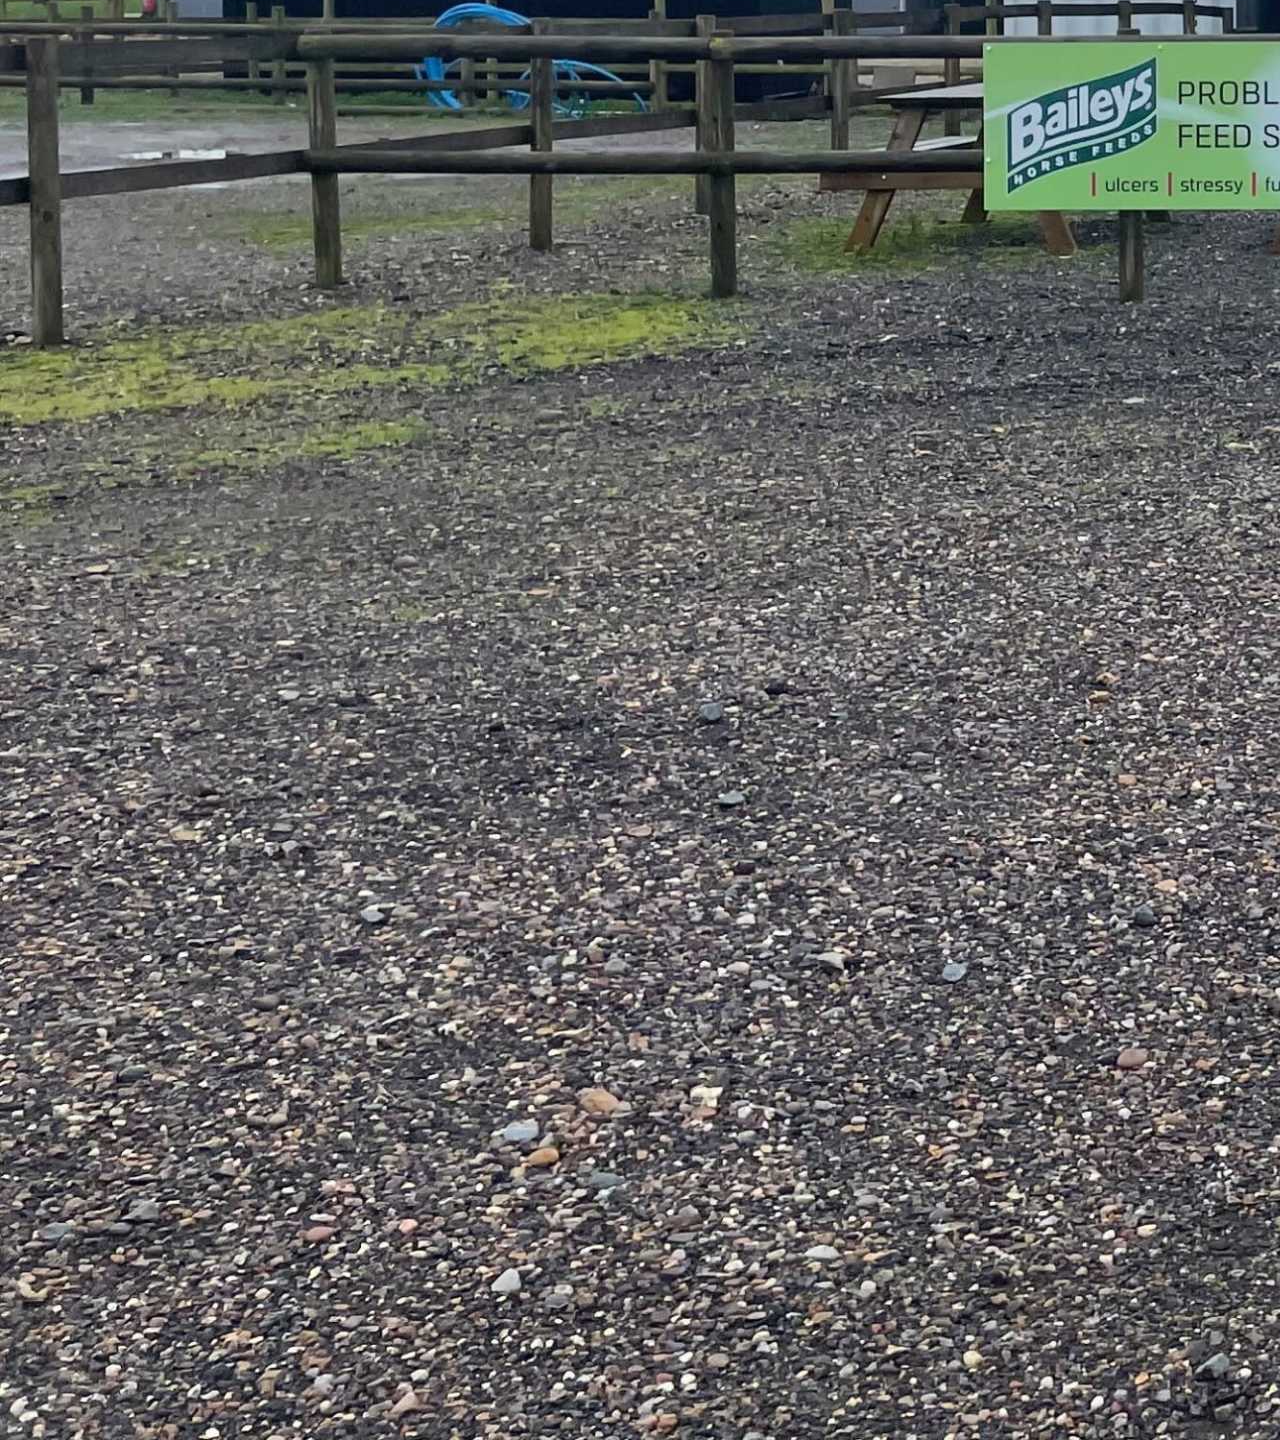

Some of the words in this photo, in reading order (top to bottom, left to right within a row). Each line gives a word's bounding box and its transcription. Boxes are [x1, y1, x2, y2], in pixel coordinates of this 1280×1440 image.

[1011, 68, 1153, 165] Baileys
[1178, 124, 1252, 149] FEED
[1014, 151, 1077, 184] HORSE
[1092, 125, 1153, 157] FEEDS
[1105, 177, 1159, 193] ulcers
[1180, 178, 1244, 195] stressy
